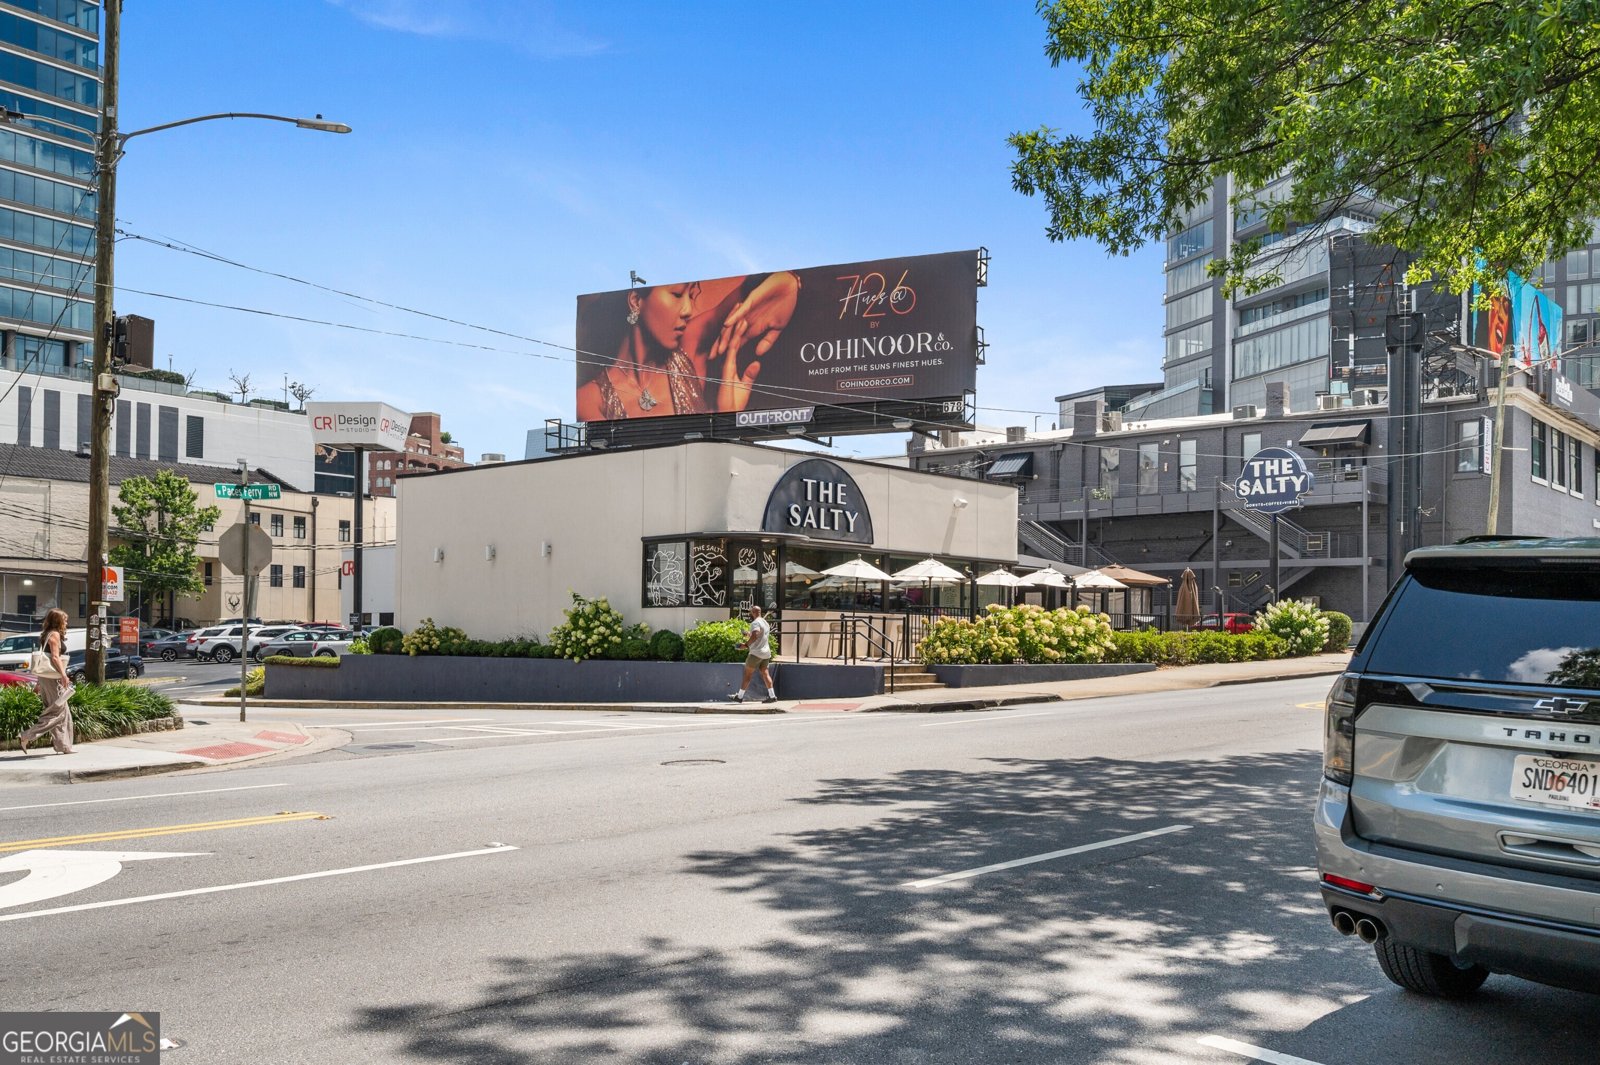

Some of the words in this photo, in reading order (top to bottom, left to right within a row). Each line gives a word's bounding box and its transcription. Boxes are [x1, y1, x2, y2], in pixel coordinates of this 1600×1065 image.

[839, 279, 888, 316] Hues
[800, 332, 933, 363] COHINOOR
[808, 367, 829, 376] MADE
[831, 365, 852, 374] FROM
[853, 364, 868, 372] THE
[870, 362, 891, 371] SUNS
[892, 360, 919, 369] FINEST
[921, 358, 944, 367] HUES.
[839, 376, 910, 389] COHINOORCO.COM
[944, 401, 962, 412] 678
[314, 416, 333, 430] CR
[338, 414, 376, 427] Design
[380, 418, 390, 433] CR
[739, 409, 811, 425] OUTFRONT
[1249, 458, 1294, 477] THE
[221, 485, 242, 497] Paces
[243, 486, 262, 498] Ferry
[802, 478, 847, 505] THE
[1238, 475, 1306, 496] SALTY
[788, 503, 859, 533] SALTY
[693, 544, 705, 552] THE
[706, 544, 724, 554] SALTY
[1503, 727, 1600, 744] TAHO
[1536, 759, 1589, 772] GEORGIA
[1522, 767, 1598, 796] SND6401
